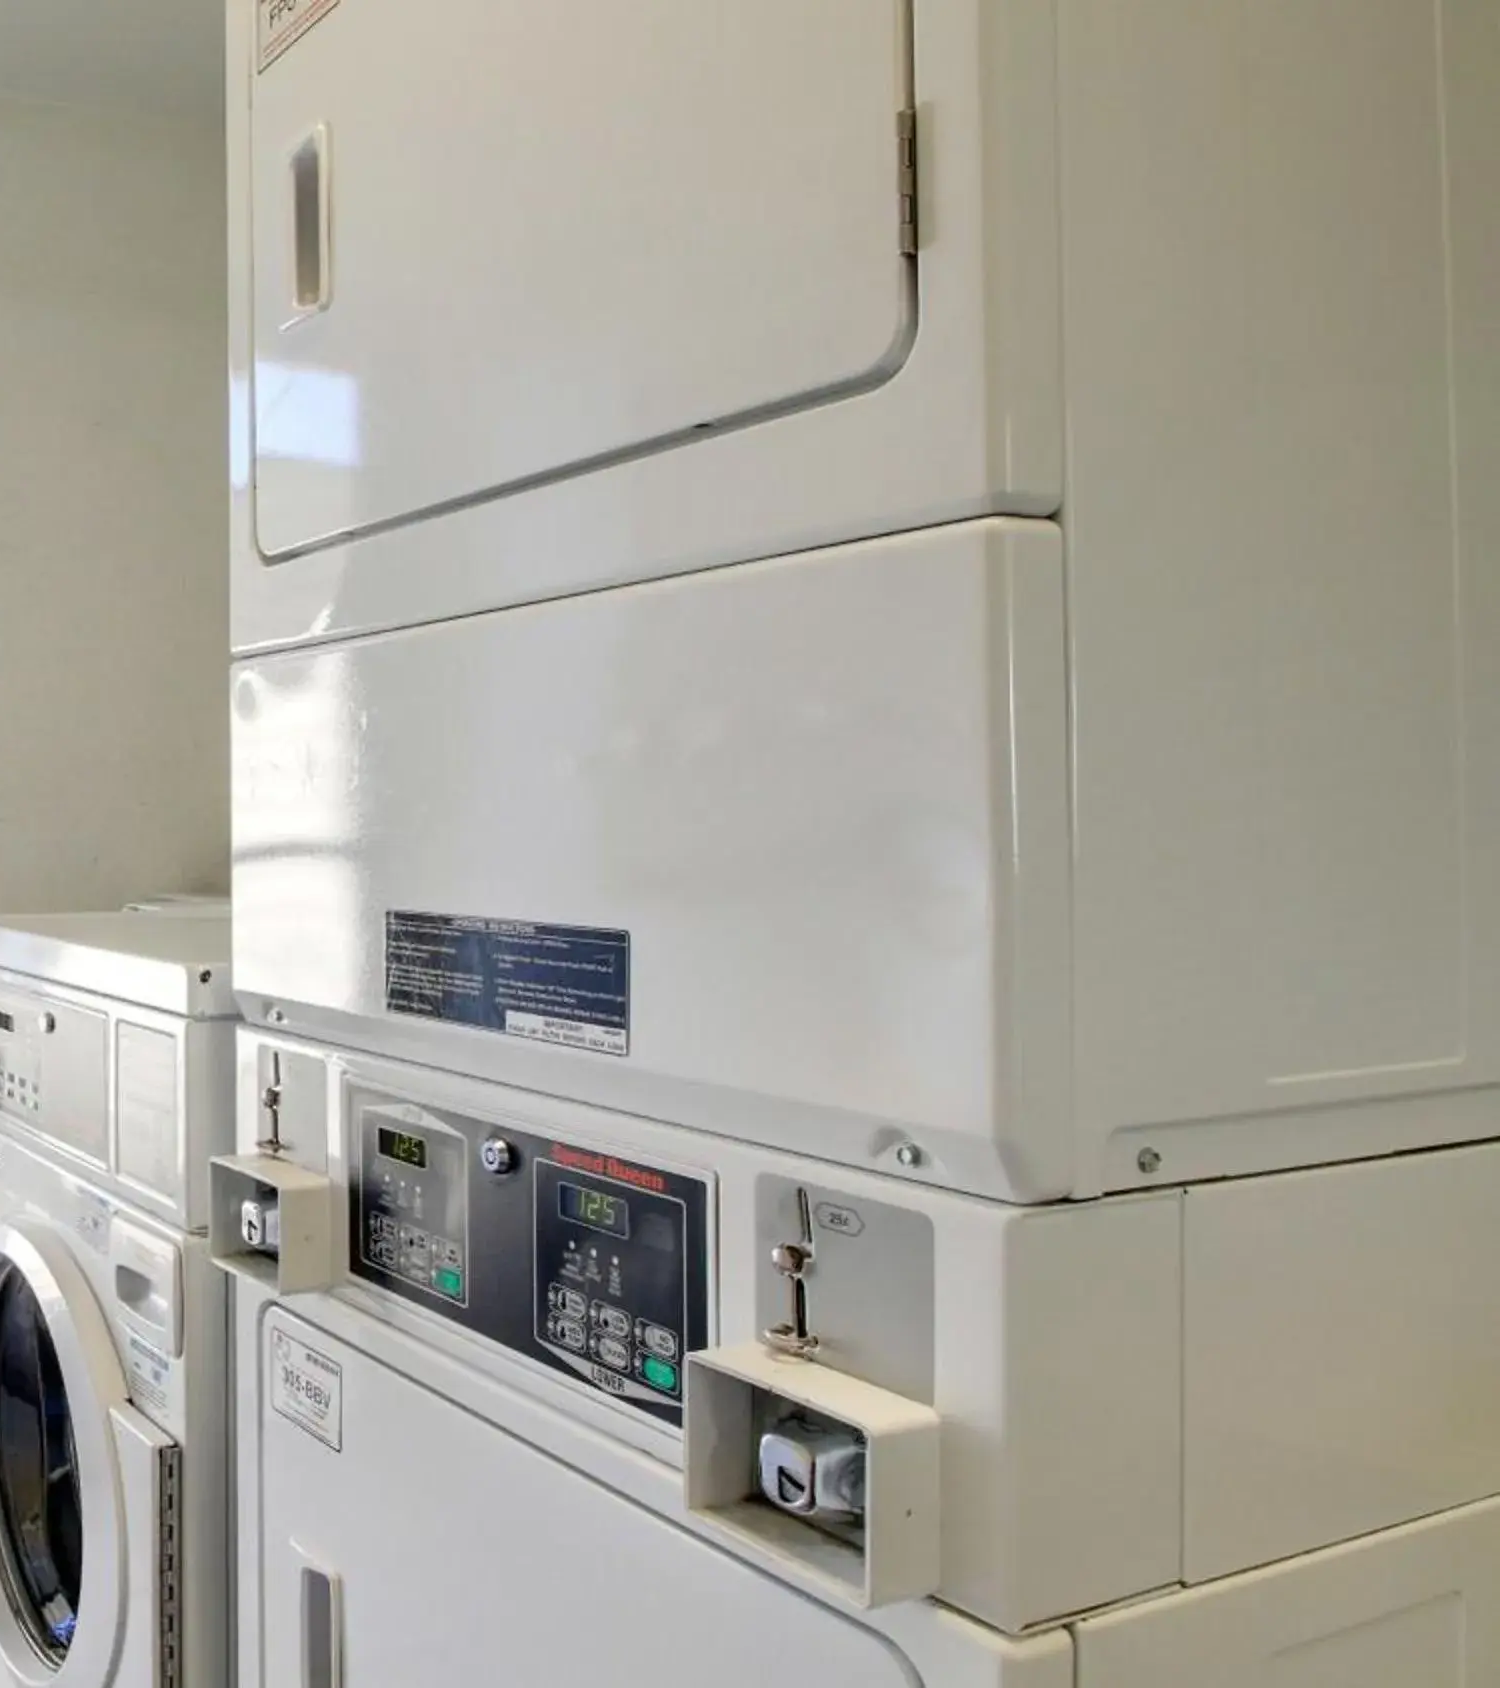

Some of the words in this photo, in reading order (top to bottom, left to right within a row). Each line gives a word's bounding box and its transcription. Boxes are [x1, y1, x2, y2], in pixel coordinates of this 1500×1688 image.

[607, 1158, 667, 1193] Queen
[579, 1190, 616, 1226] 125
[590, 1366, 626, 1393] LOWER
